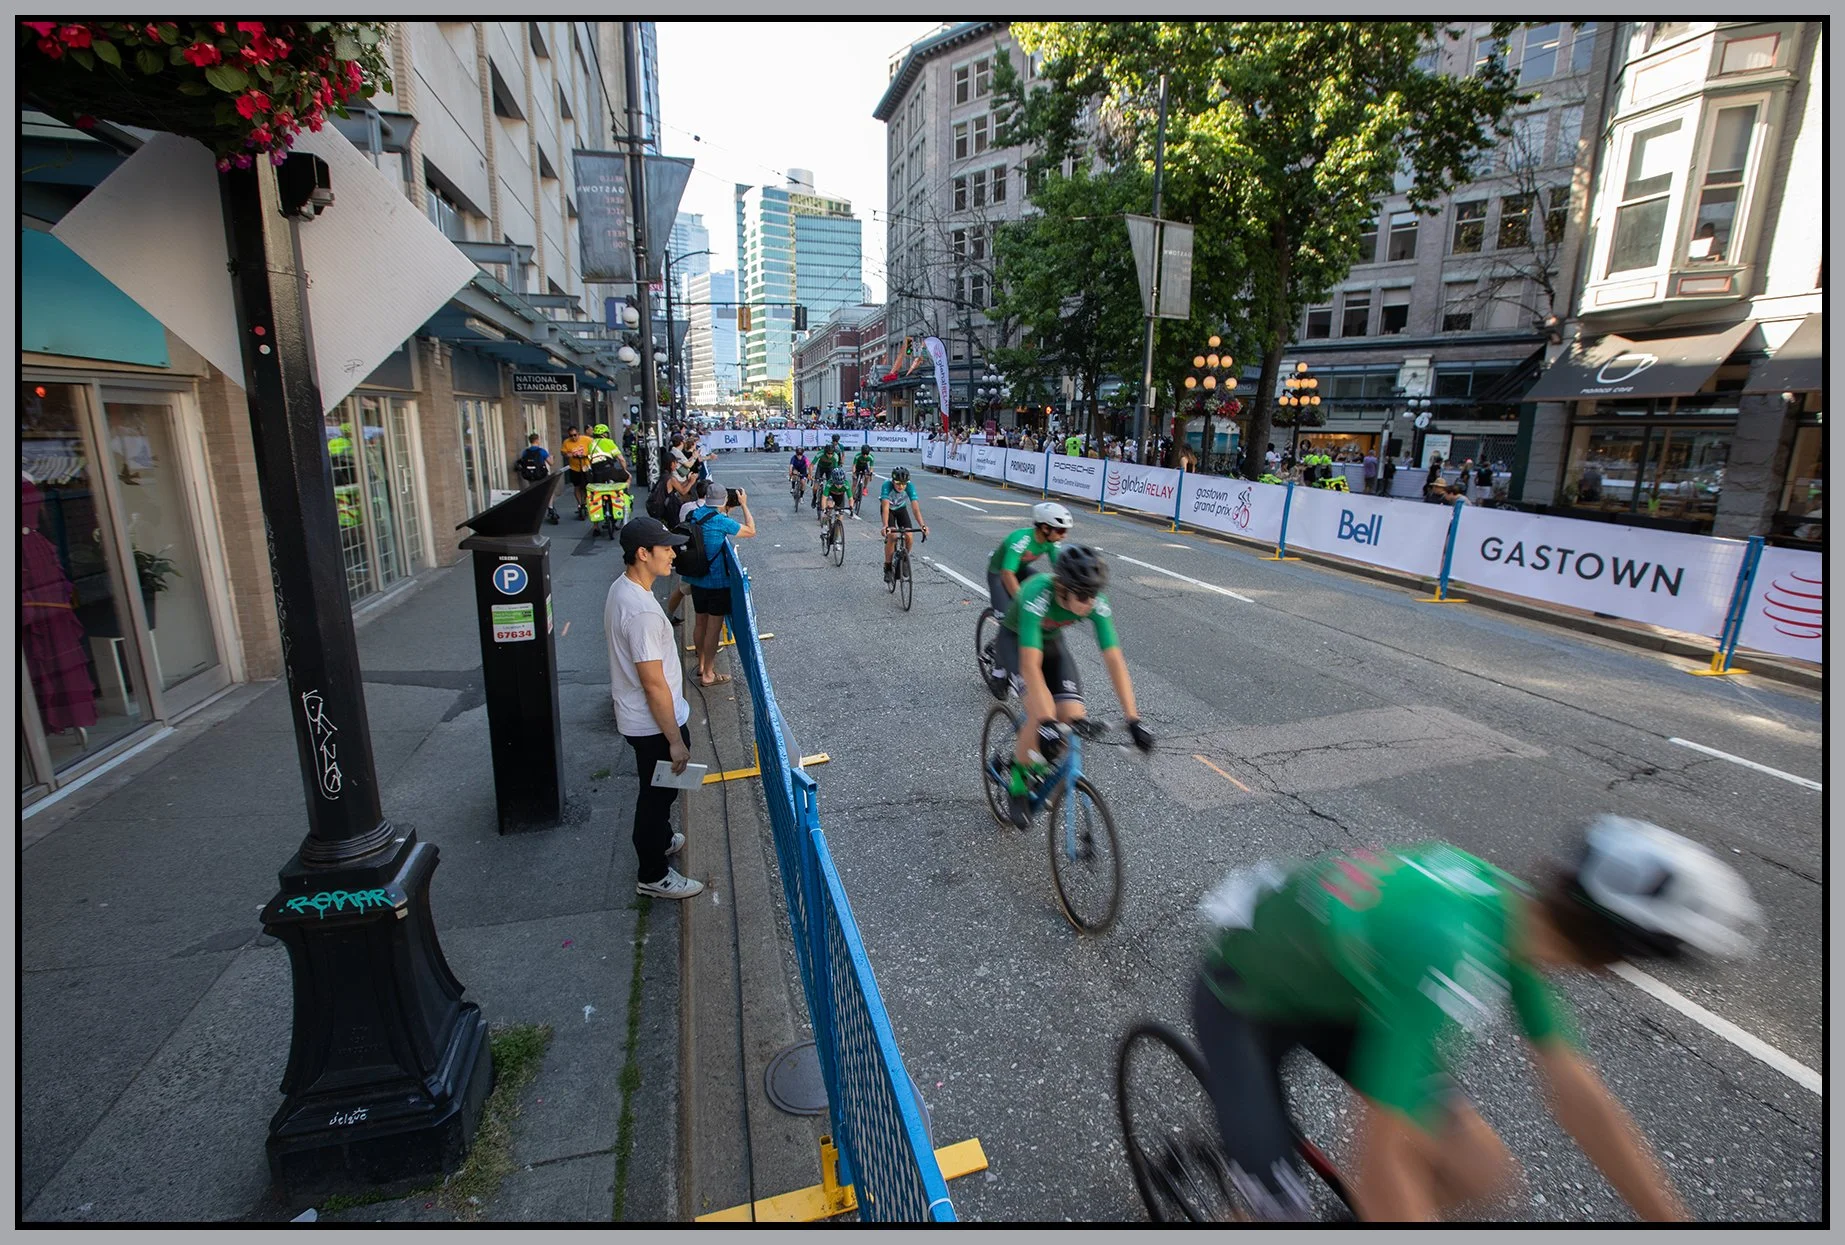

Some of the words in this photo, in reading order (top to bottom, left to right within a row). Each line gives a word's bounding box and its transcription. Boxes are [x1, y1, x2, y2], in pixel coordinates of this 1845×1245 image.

[515, 375, 557, 383] NATIONAL
[516, 383, 568, 392] STANDARDS
[724, 434, 738, 444] Bell
[1053, 461, 1096, 475] PORSCHE
[1195, 487, 1228, 502] gastown
[1193, 500, 1214, 514] grand
[1215, 503, 1232, 517] prix
[1337, 509, 1383, 546] Bell
[1480, 536, 1685, 597] GASTOWN
[503, 569, 520, 590] P
[496, 629, 533, 640] 67634
